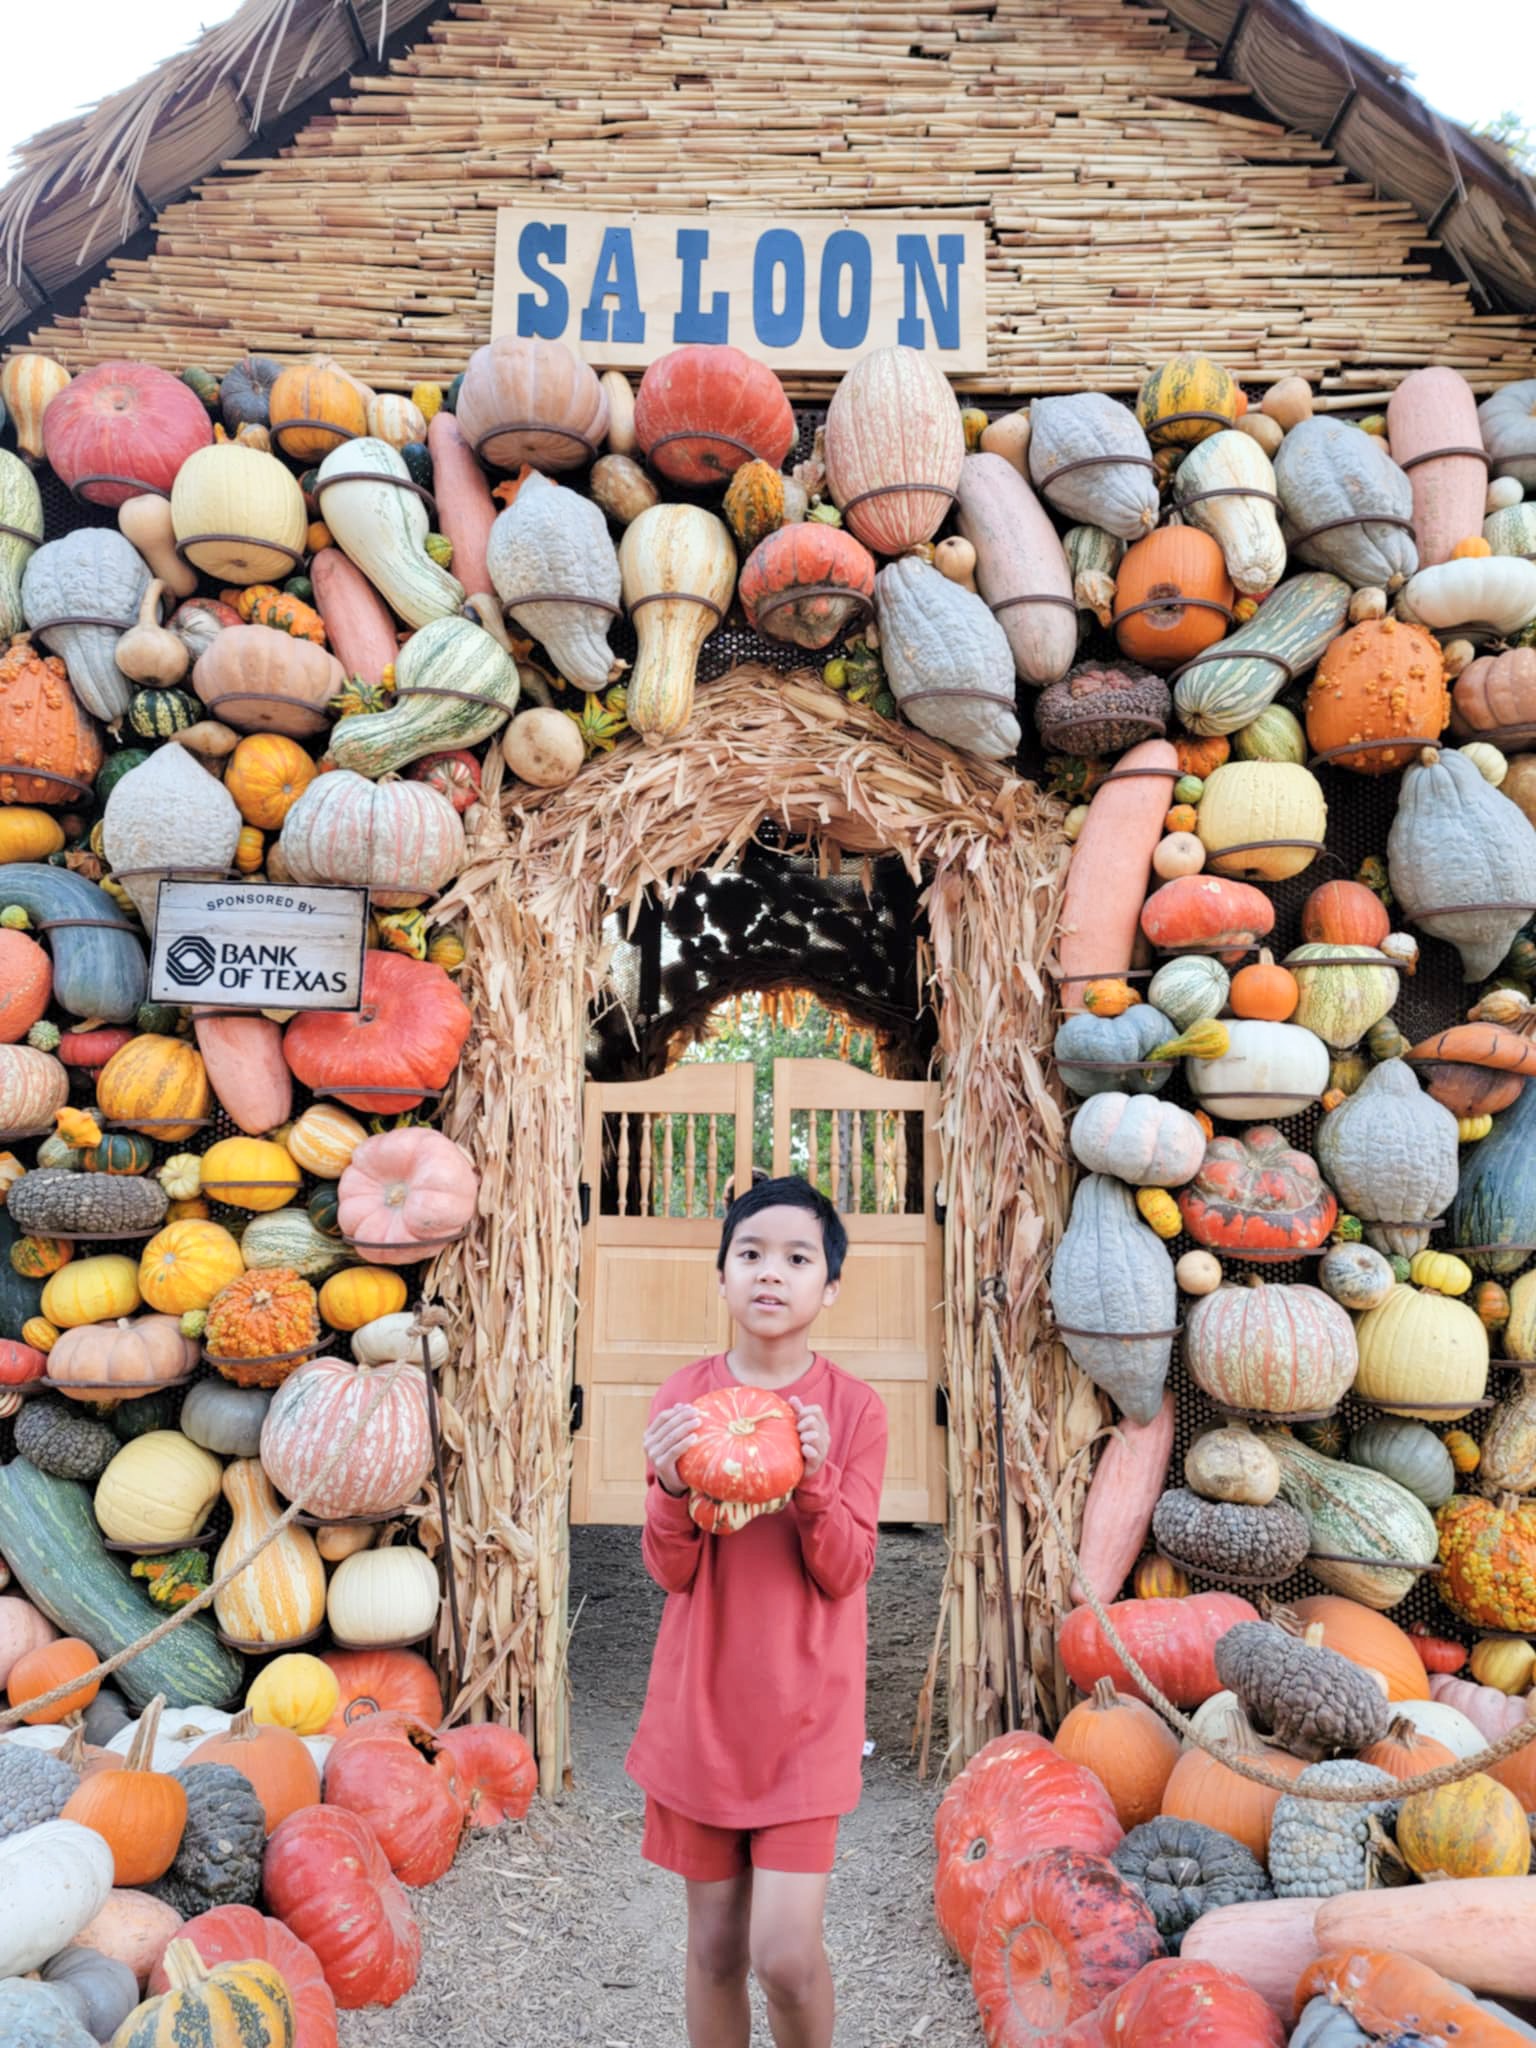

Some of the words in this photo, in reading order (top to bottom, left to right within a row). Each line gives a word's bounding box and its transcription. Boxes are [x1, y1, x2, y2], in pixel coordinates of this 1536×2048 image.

[517, 221, 965, 349] SALOON
[207, 894, 293, 911] SPONSORED
[297, 902, 317, 914] BY
[221, 943, 297, 967] BANK
[219, 968, 253, 989] OF
[262, 969, 347, 993] TEXAS
